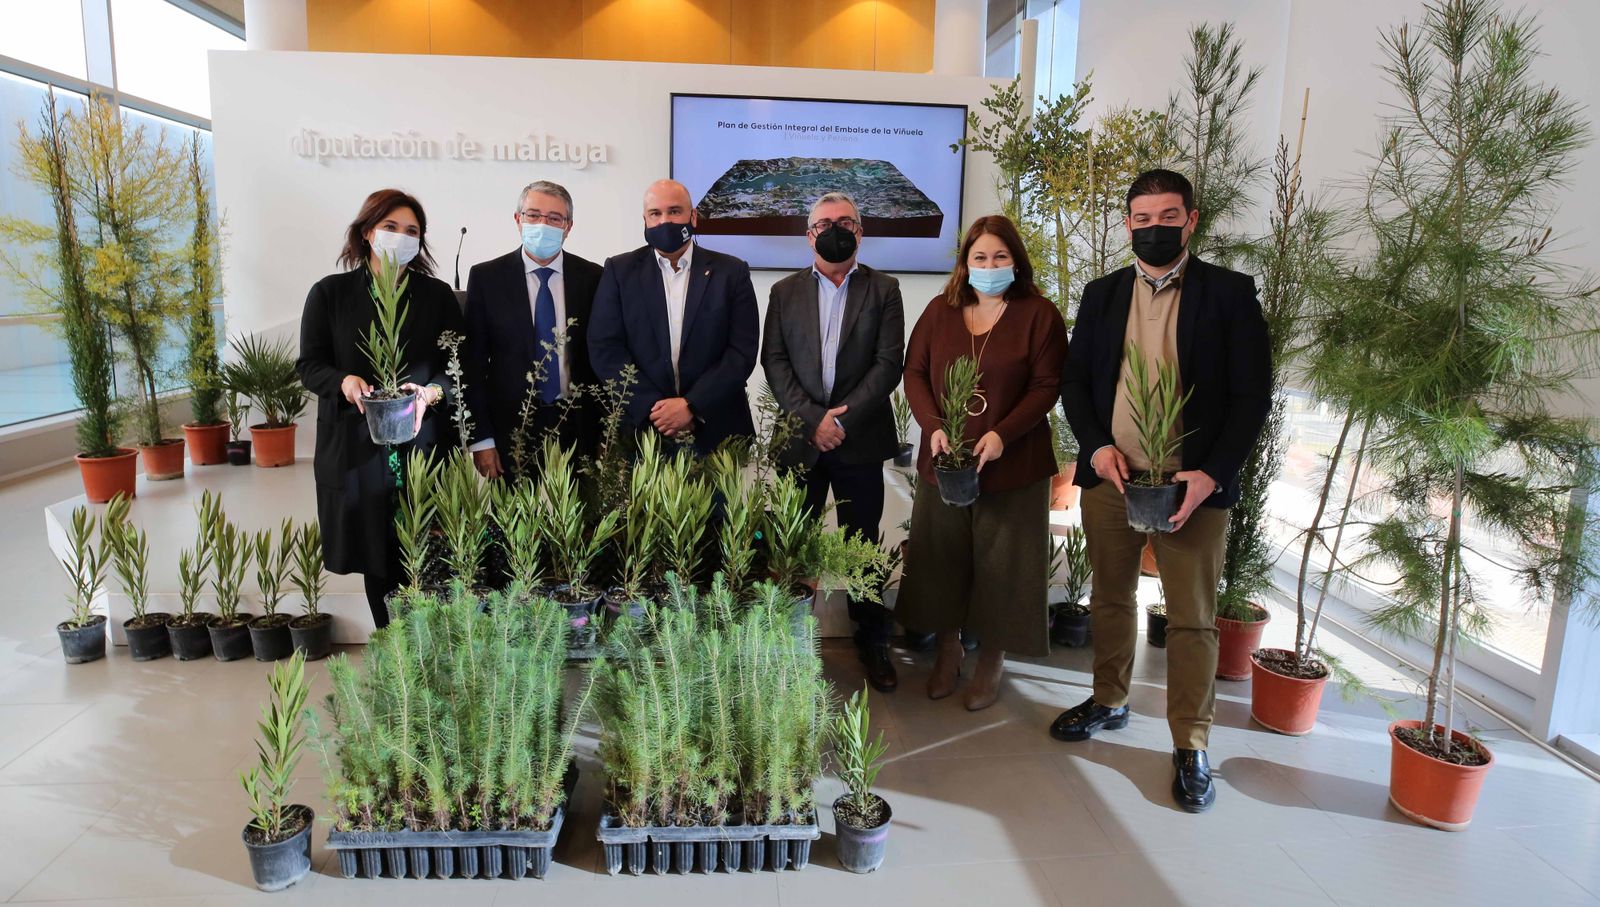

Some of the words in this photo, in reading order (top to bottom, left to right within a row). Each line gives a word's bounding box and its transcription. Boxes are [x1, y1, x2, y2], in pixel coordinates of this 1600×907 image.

[717, 121, 736, 129] Plan
[750, 122, 783, 131] Gestión
[784, 123, 818, 133] Integral
[834, 125, 870, 134] Embalse
[871, 127, 882, 135] de
[883, 127, 892, 135] la
[893, 127, 924, 136] Viñuela
[288, 126, 434, 165] diputación
[443, 130, 478, 160] de
[490, 131, 608, 170] málaga
